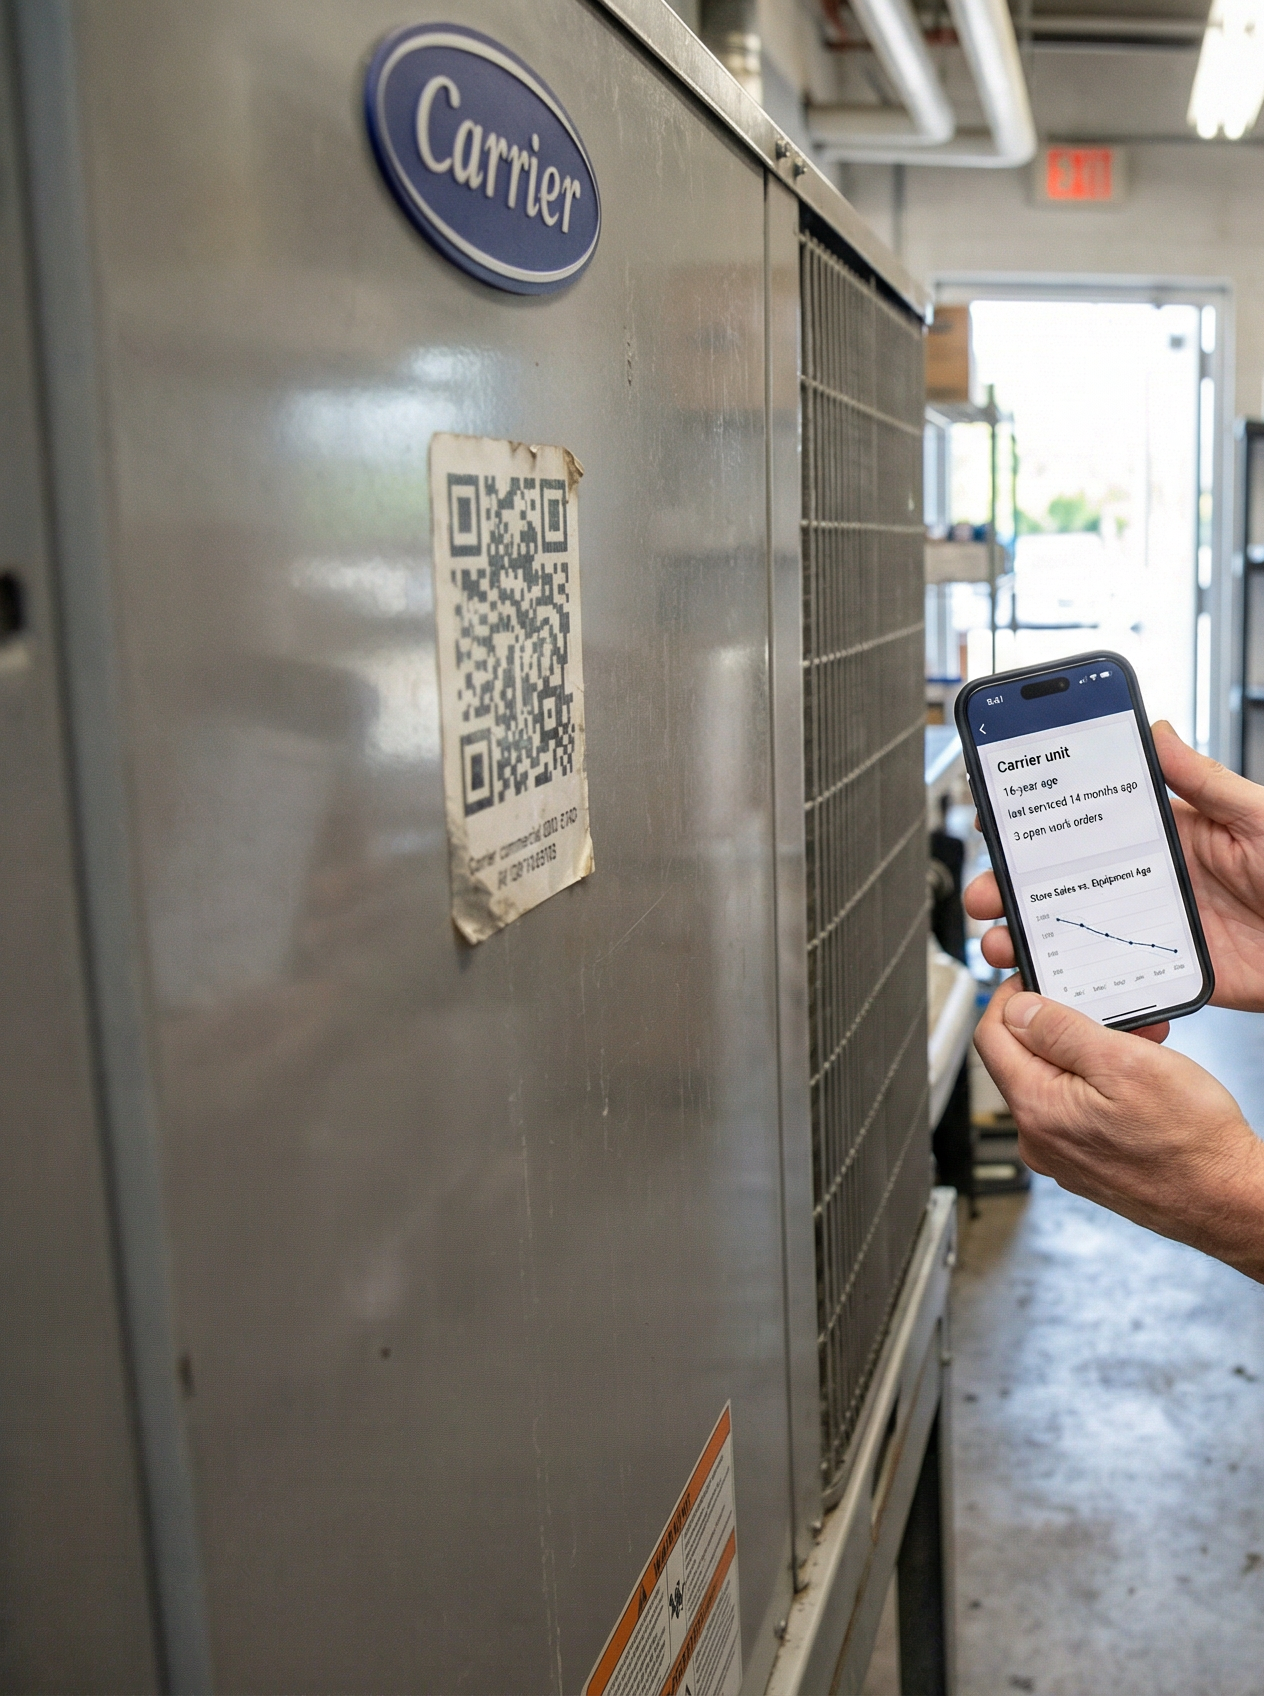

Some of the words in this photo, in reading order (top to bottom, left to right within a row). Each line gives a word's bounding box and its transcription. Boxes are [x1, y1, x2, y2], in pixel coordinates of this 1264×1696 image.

[416, 74, 581, 234] Carrier
[997, 753, 1042, 773] Carrier
[1045, 746, 1071, 762] unit
[1070, 794, 1082, 804] 14
[1084, 785, 1119, 801] months
[1023, 826, 1047, 841] open
[1073, 812, 1103, 827] orders
[1030, 891, 1053, 903] Store
